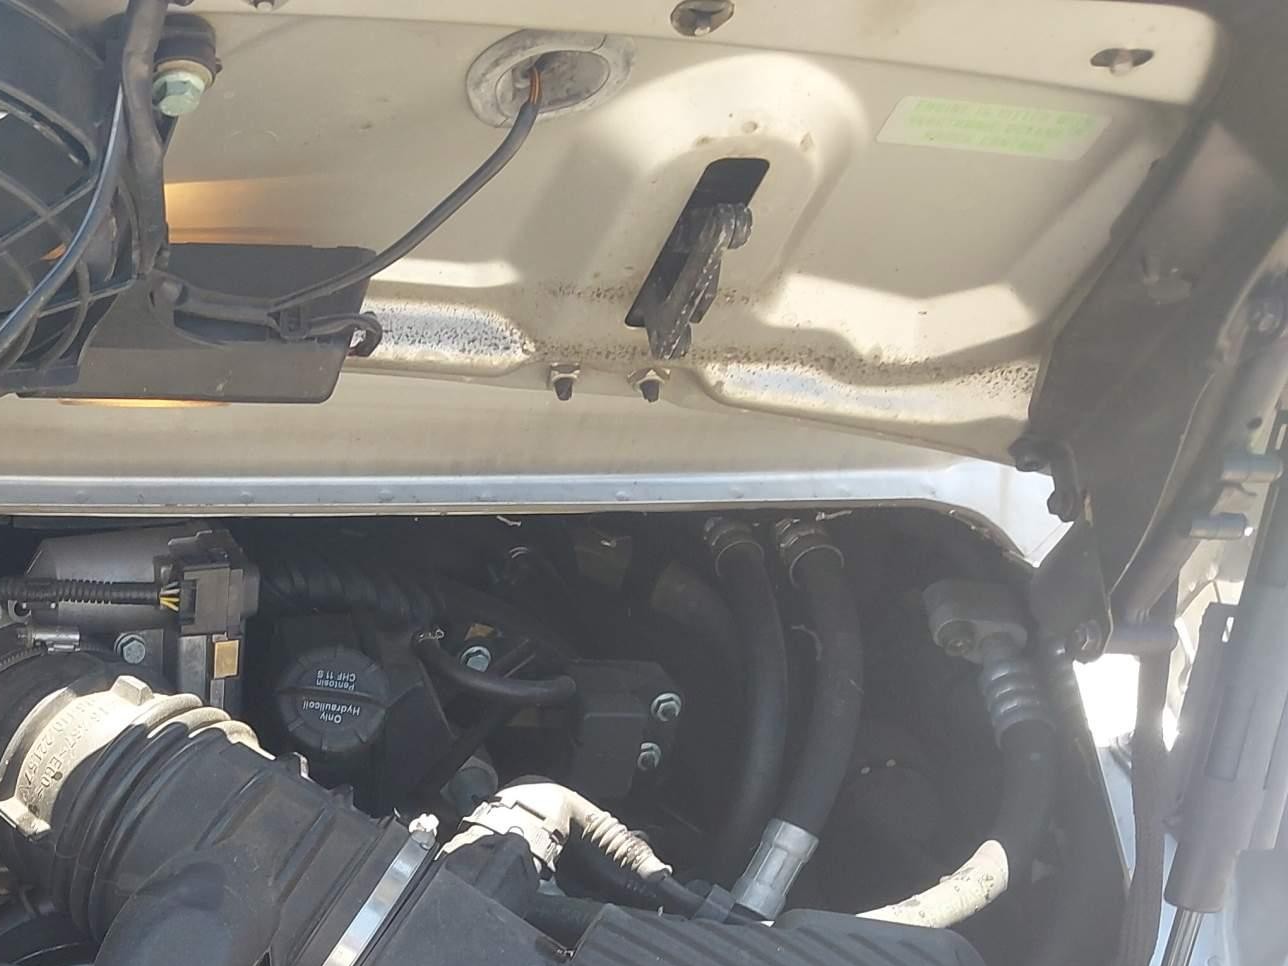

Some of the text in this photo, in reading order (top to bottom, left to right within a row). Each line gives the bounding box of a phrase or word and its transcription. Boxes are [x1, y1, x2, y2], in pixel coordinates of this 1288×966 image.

[326, 670, 334, 680] 11
[337, 672, 356, 682] CHF
[316, 679, 355, 691] Pentosin
[302, 701, 360, 716] Hydraulicoil
[320, 711, 342, 724] Only
